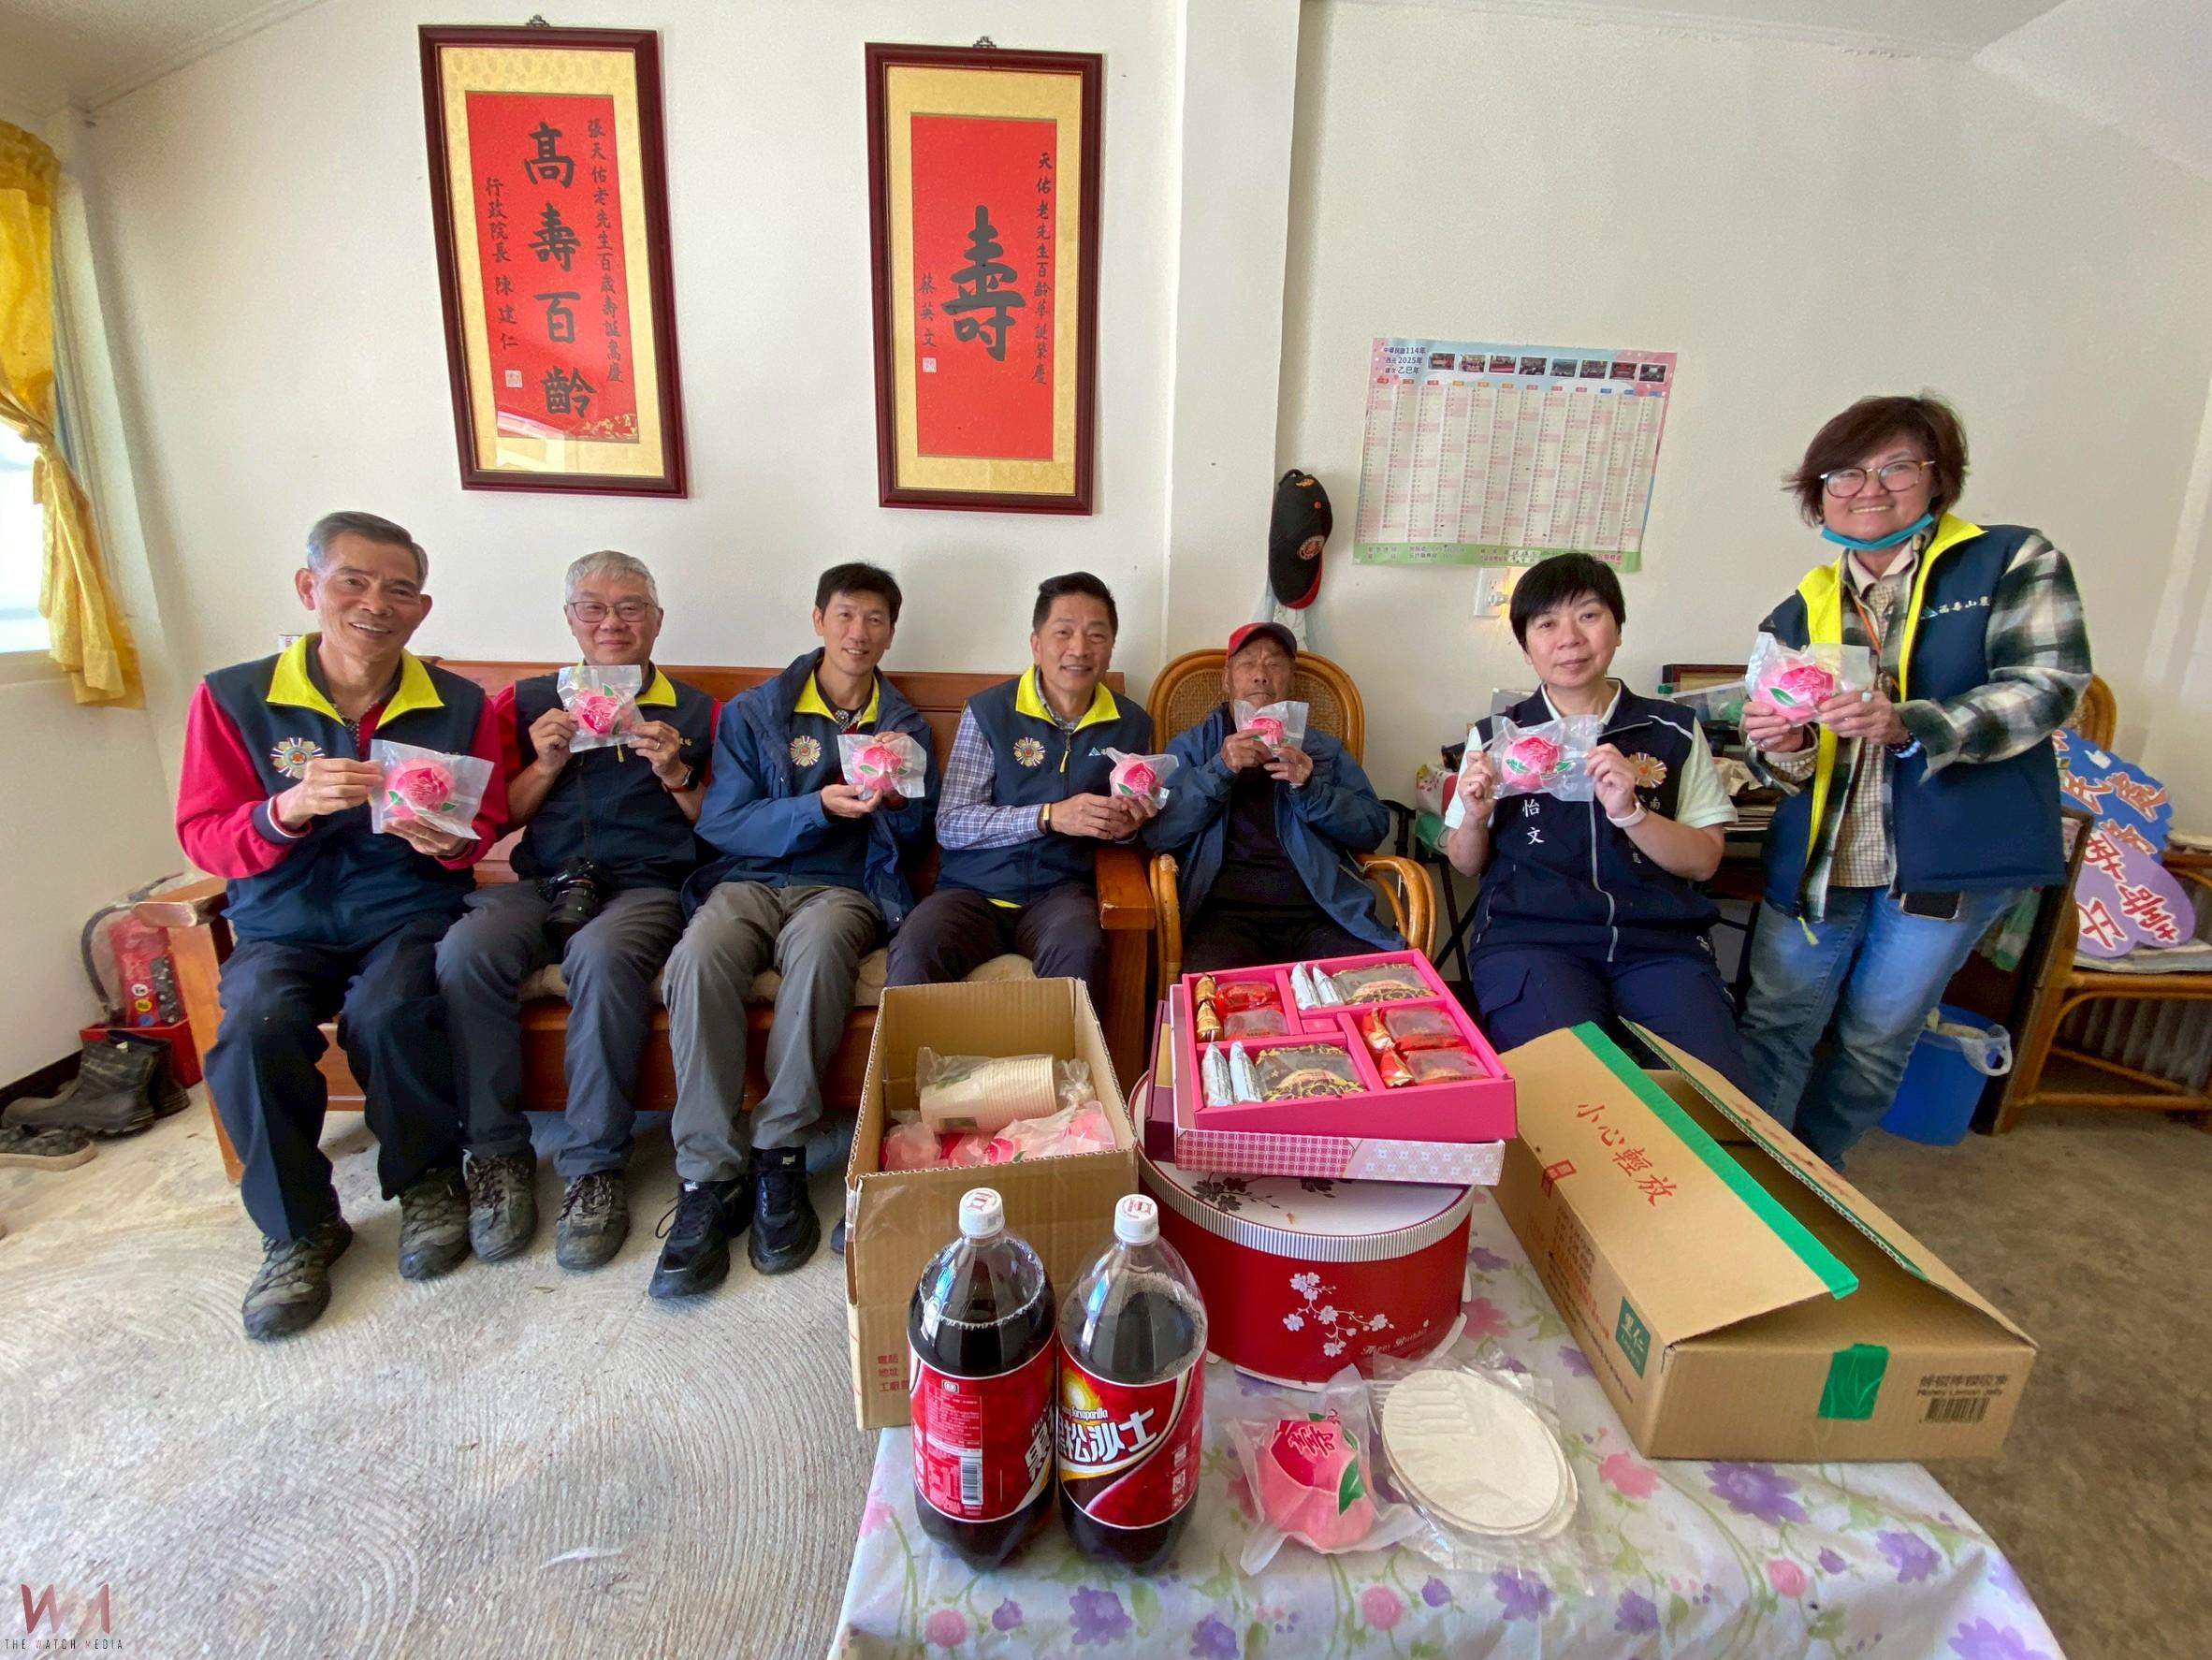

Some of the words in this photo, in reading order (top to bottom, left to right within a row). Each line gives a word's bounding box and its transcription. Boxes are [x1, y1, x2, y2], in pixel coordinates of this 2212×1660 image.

[524, 122, 598, 418] 高壽百齡
[919, 273, 937, 348] 蔡英文
[940, 205, 1026, 362] 壽
[1521, 798, 1545, 845] 怡文
[1576, 1104, 1677, 1206] 小心輕放
[1620, 1311, 1645, 1353] 里仁
